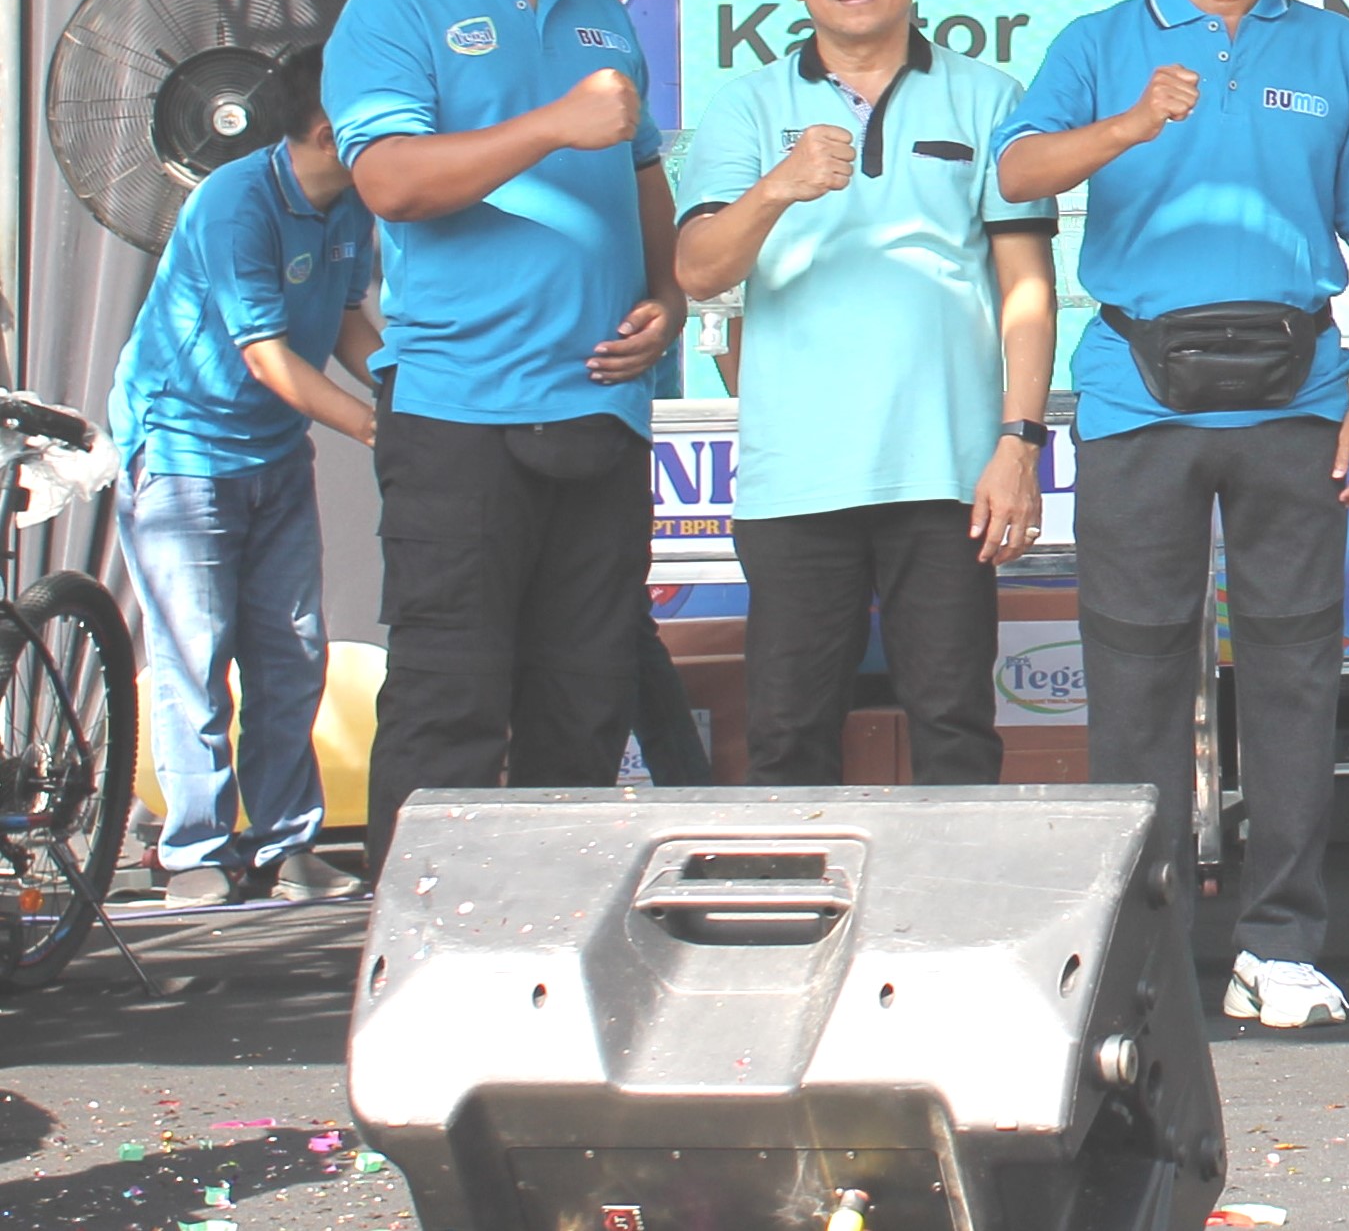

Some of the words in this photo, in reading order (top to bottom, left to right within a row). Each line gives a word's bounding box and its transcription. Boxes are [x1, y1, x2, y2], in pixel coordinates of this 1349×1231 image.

[718, 2, 1030, 68] Kor
[653, 439, 739, 505] NK
[652, 519, 676, 536] PT
[680, 519, 720, 536] BPR
[1006, 656, 1085, 698] Tega
